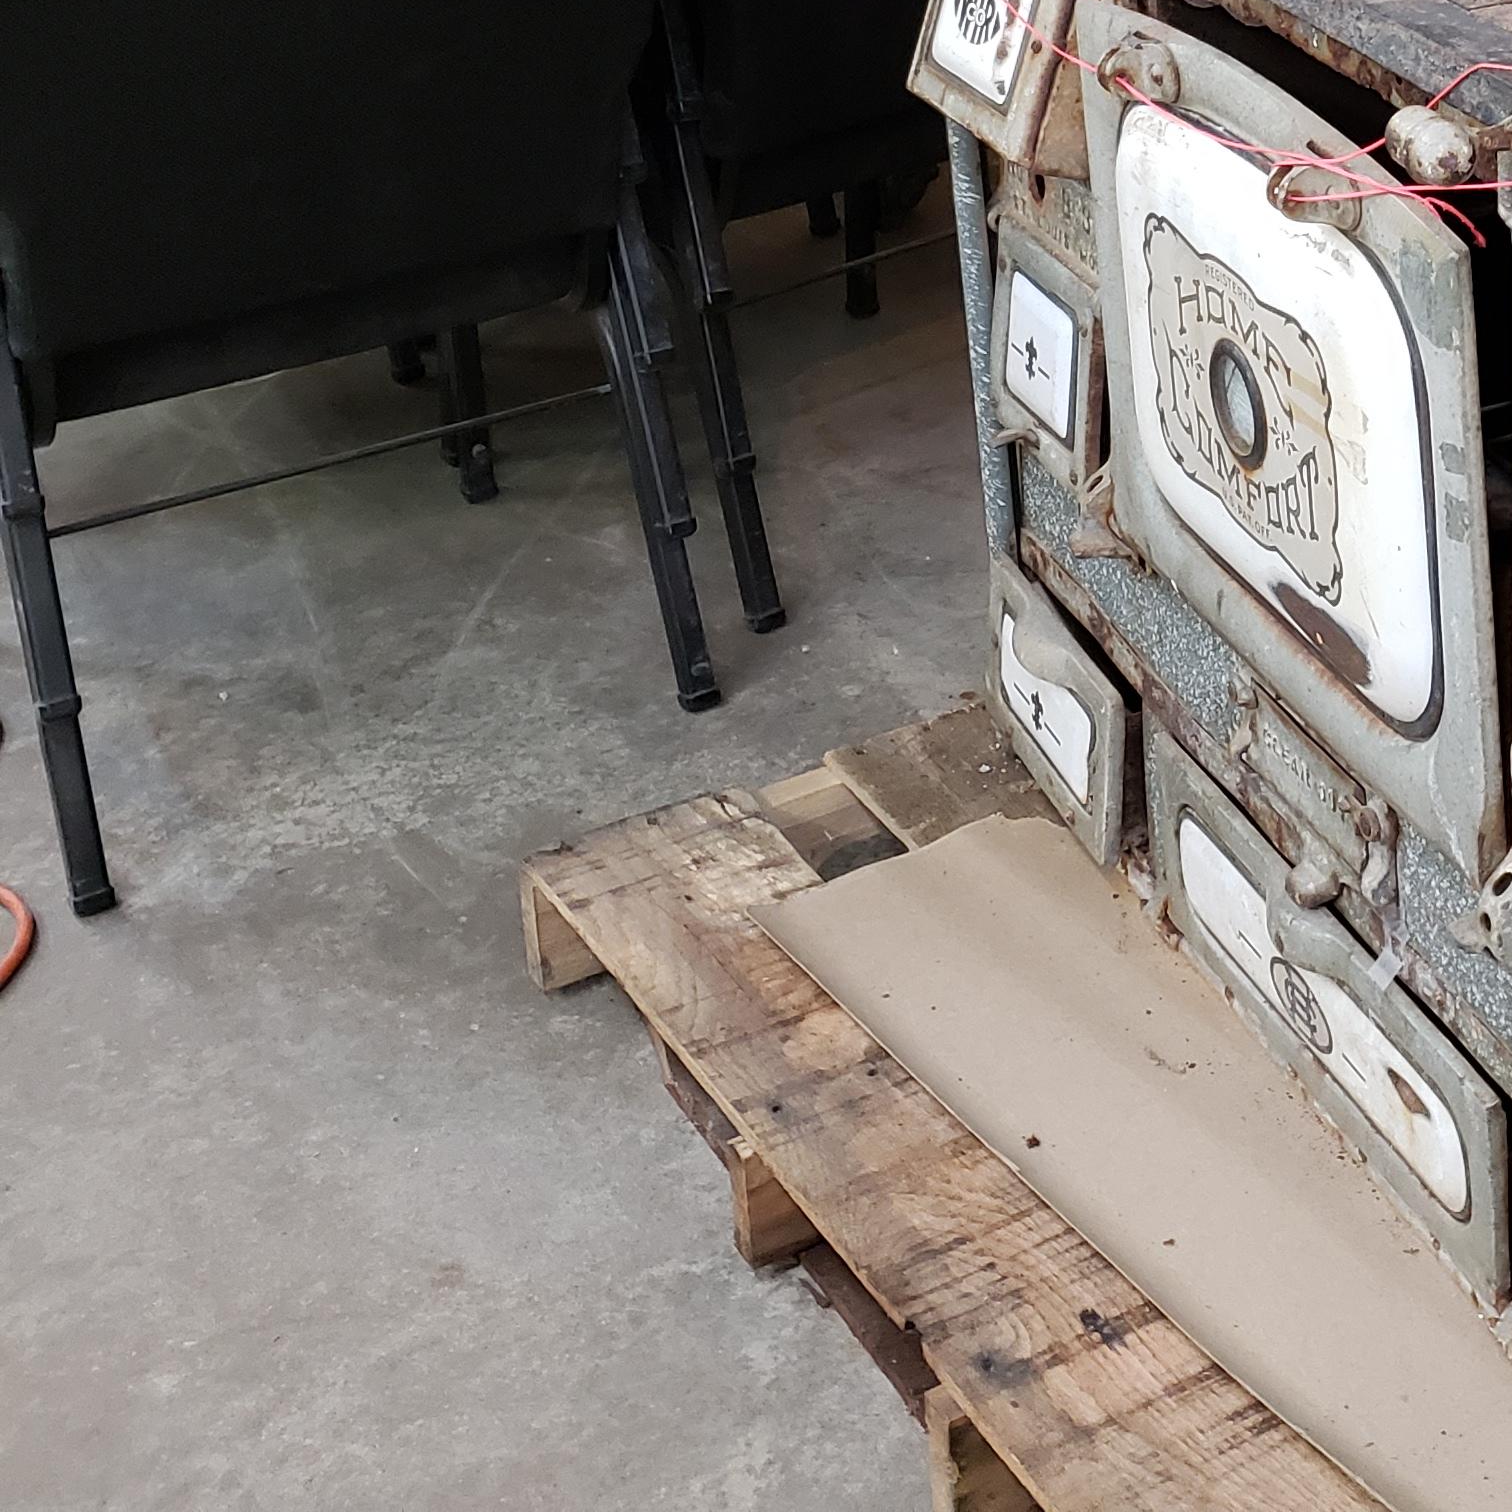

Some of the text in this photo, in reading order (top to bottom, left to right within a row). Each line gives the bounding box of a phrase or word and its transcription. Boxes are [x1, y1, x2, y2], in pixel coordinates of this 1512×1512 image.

[1174, 275, 1295, 431] HOME
[1204, 263, 1255, 312] REGISTERED
[1163, 321, 1319, 541] COMFORT
